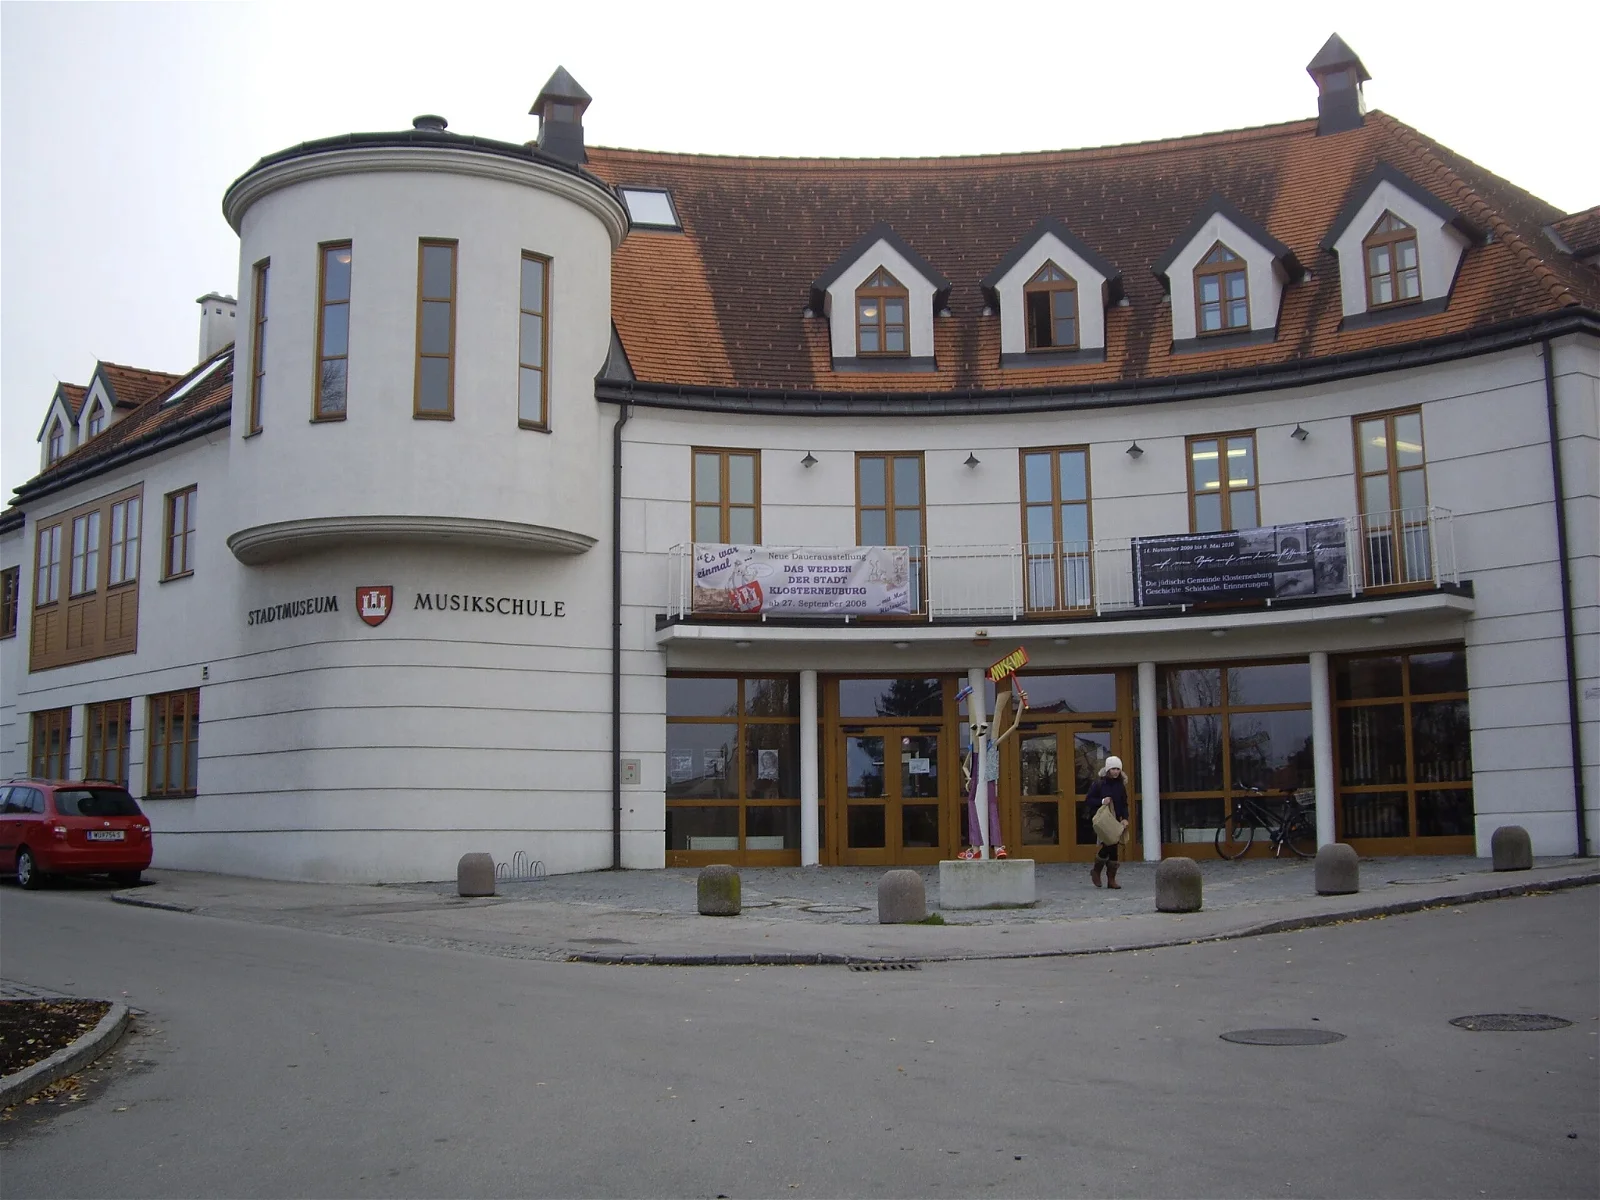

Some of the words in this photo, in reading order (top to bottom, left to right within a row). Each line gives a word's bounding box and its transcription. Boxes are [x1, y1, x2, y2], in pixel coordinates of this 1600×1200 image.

[718, 546, 739, 559] war
[768, 552, 789, 560] Neue
[792, 553, 867, 561] Dauerausstellung
[697, 558, 732, 578] einmal
[784, 565, 803, 573] DAS
[807, 565, 852, 573] WERDEN
[788, 576, 810, 584] DER
[813, 576, 848, 584] STADT
[1157, 578, 1186, 587] jüdische
[1186, 576, 1221, 584] Gemeinde
[1222, 571, 1273, 582] Klosterneuburg
[769, 586, 867, 595] KLOSTERNEUBURG
[1145, 587, 1184, 595] Geschichte.
[1184, 584, 1221, 593] Schicksale.
[1223, 580, 1271, 591] Erinnerungen.
[769, 599, 779, 607] ab
[782, 599, 795, 607] 27.
[798, 599, 843, 608] September
[845, 600, 867, 608] 2008
[247, 596, 339, 626] STADTMUSEUM
[414, 593, 566, 617] MUSIKSCHULE
